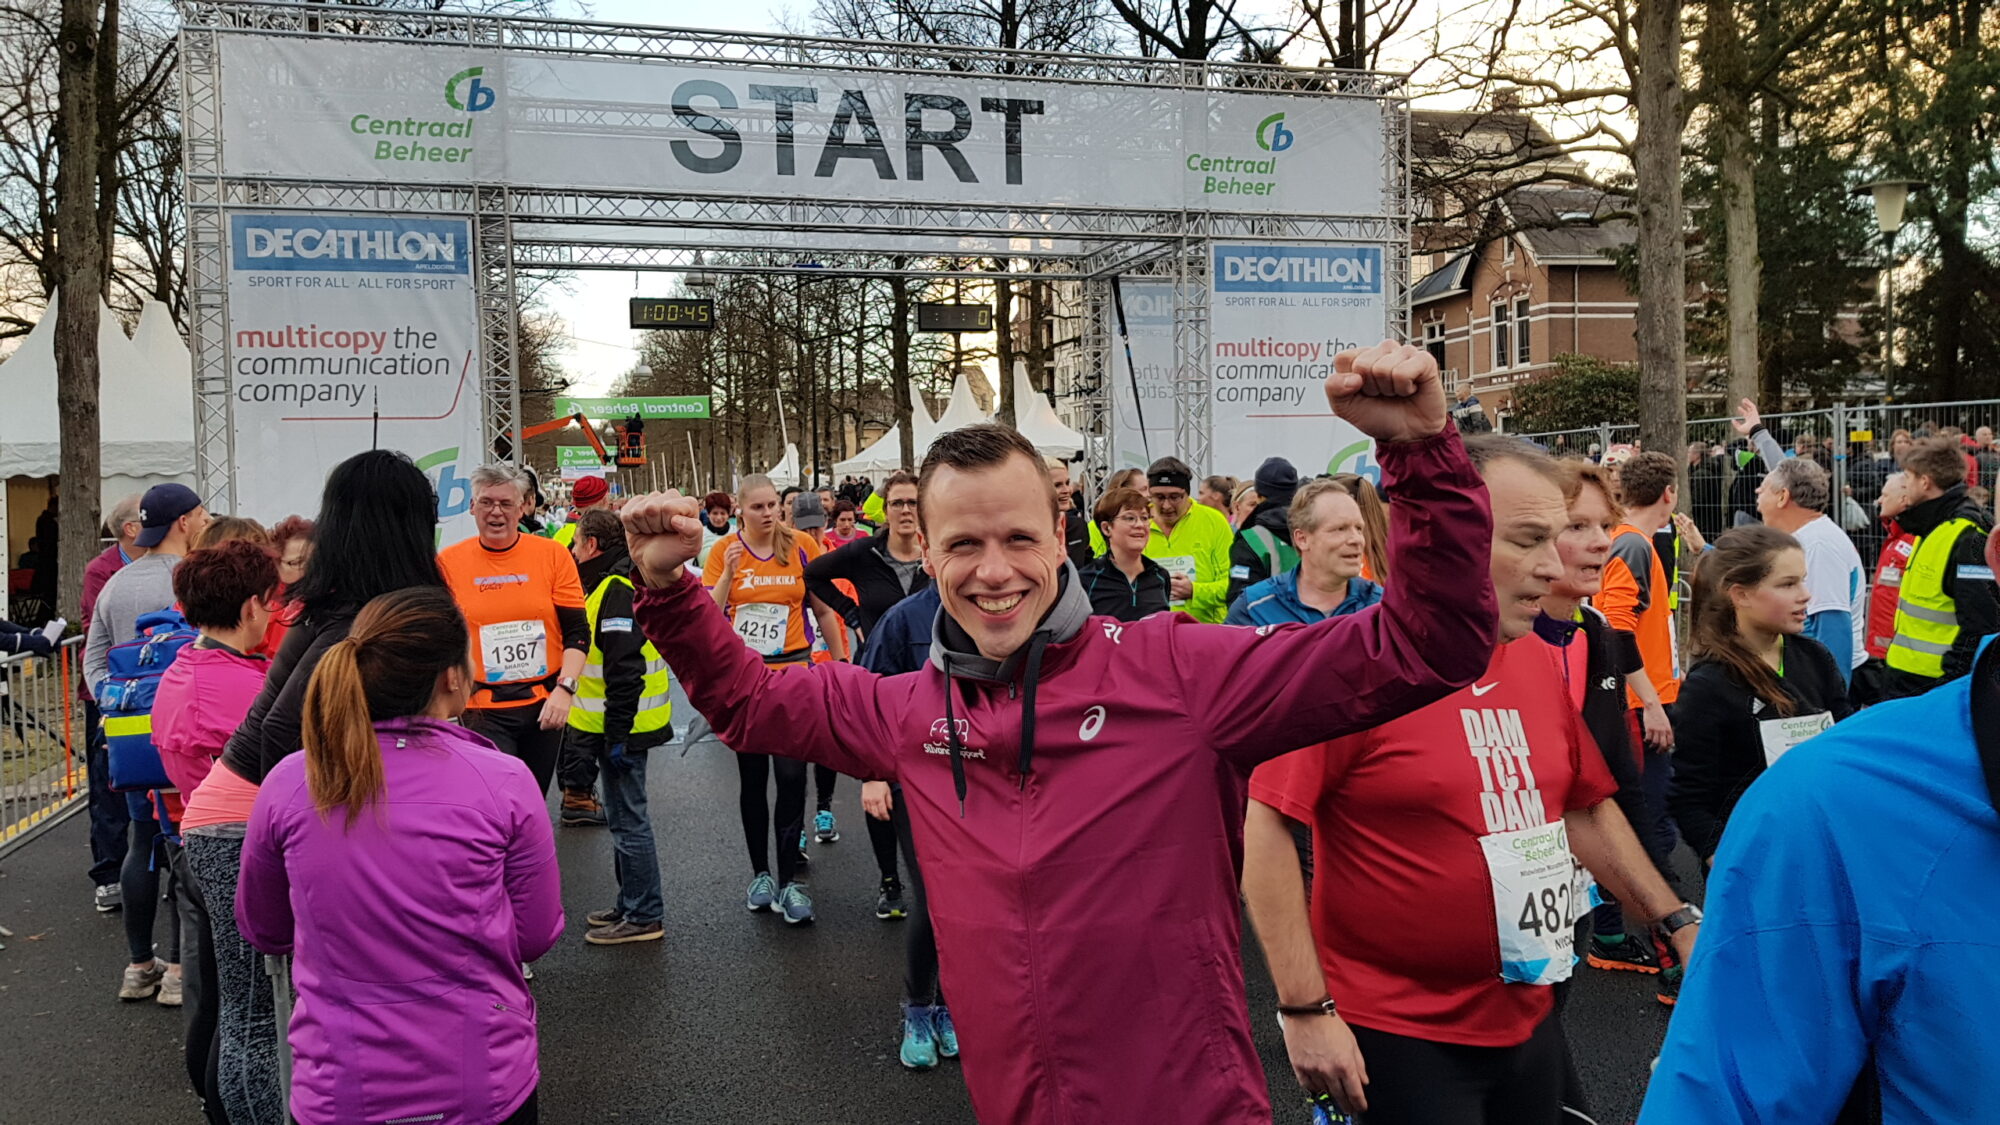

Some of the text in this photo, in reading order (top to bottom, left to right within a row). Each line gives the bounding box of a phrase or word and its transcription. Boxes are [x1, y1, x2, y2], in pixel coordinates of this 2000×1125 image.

[351, 114, 473, 138] Centraal
[669, 79, 1044, 185] START
[374, 140, 473, 163] Beheer
[1186, 153, 1277, 175] Centraal
[1203, 176, 1276, 196] Beheer
[245, 227, 455, 262] DECATHLON
[1223, 256, 1372, 283] DECATHLON
[248, 276, 456, 290] SPORT FOR ALL ALL FOR SPORT
[643, 304, 708, 322] 1:00:45
[1225, 297, 1372, 307] SPORT FOR ALL ALL FOR SPORT
[236, 324, 437, 354] multicopy the
[1216, 336, 1321, 362] multicopy
[237, 353, 450, 375] communication
[1216, 361, 1336, 380] communicat
[238, 383, 366, 408] company
[1216, 386, 1306, 407] company
[754, 575, 772, 585] RUN
[776, 575, 796, 585] KIKA
[739, 620, 779, 640] 4215
[491, 641, 538, 664] 1367
[1459, 708, 1528, 747] DAM
[1479, 789, 1546, 833] DAM
[1513, 831, 1555, 849] Centraal
[1525, 846, 1556, 861] Beheer
[1518, 878, 1574, 937] 482
